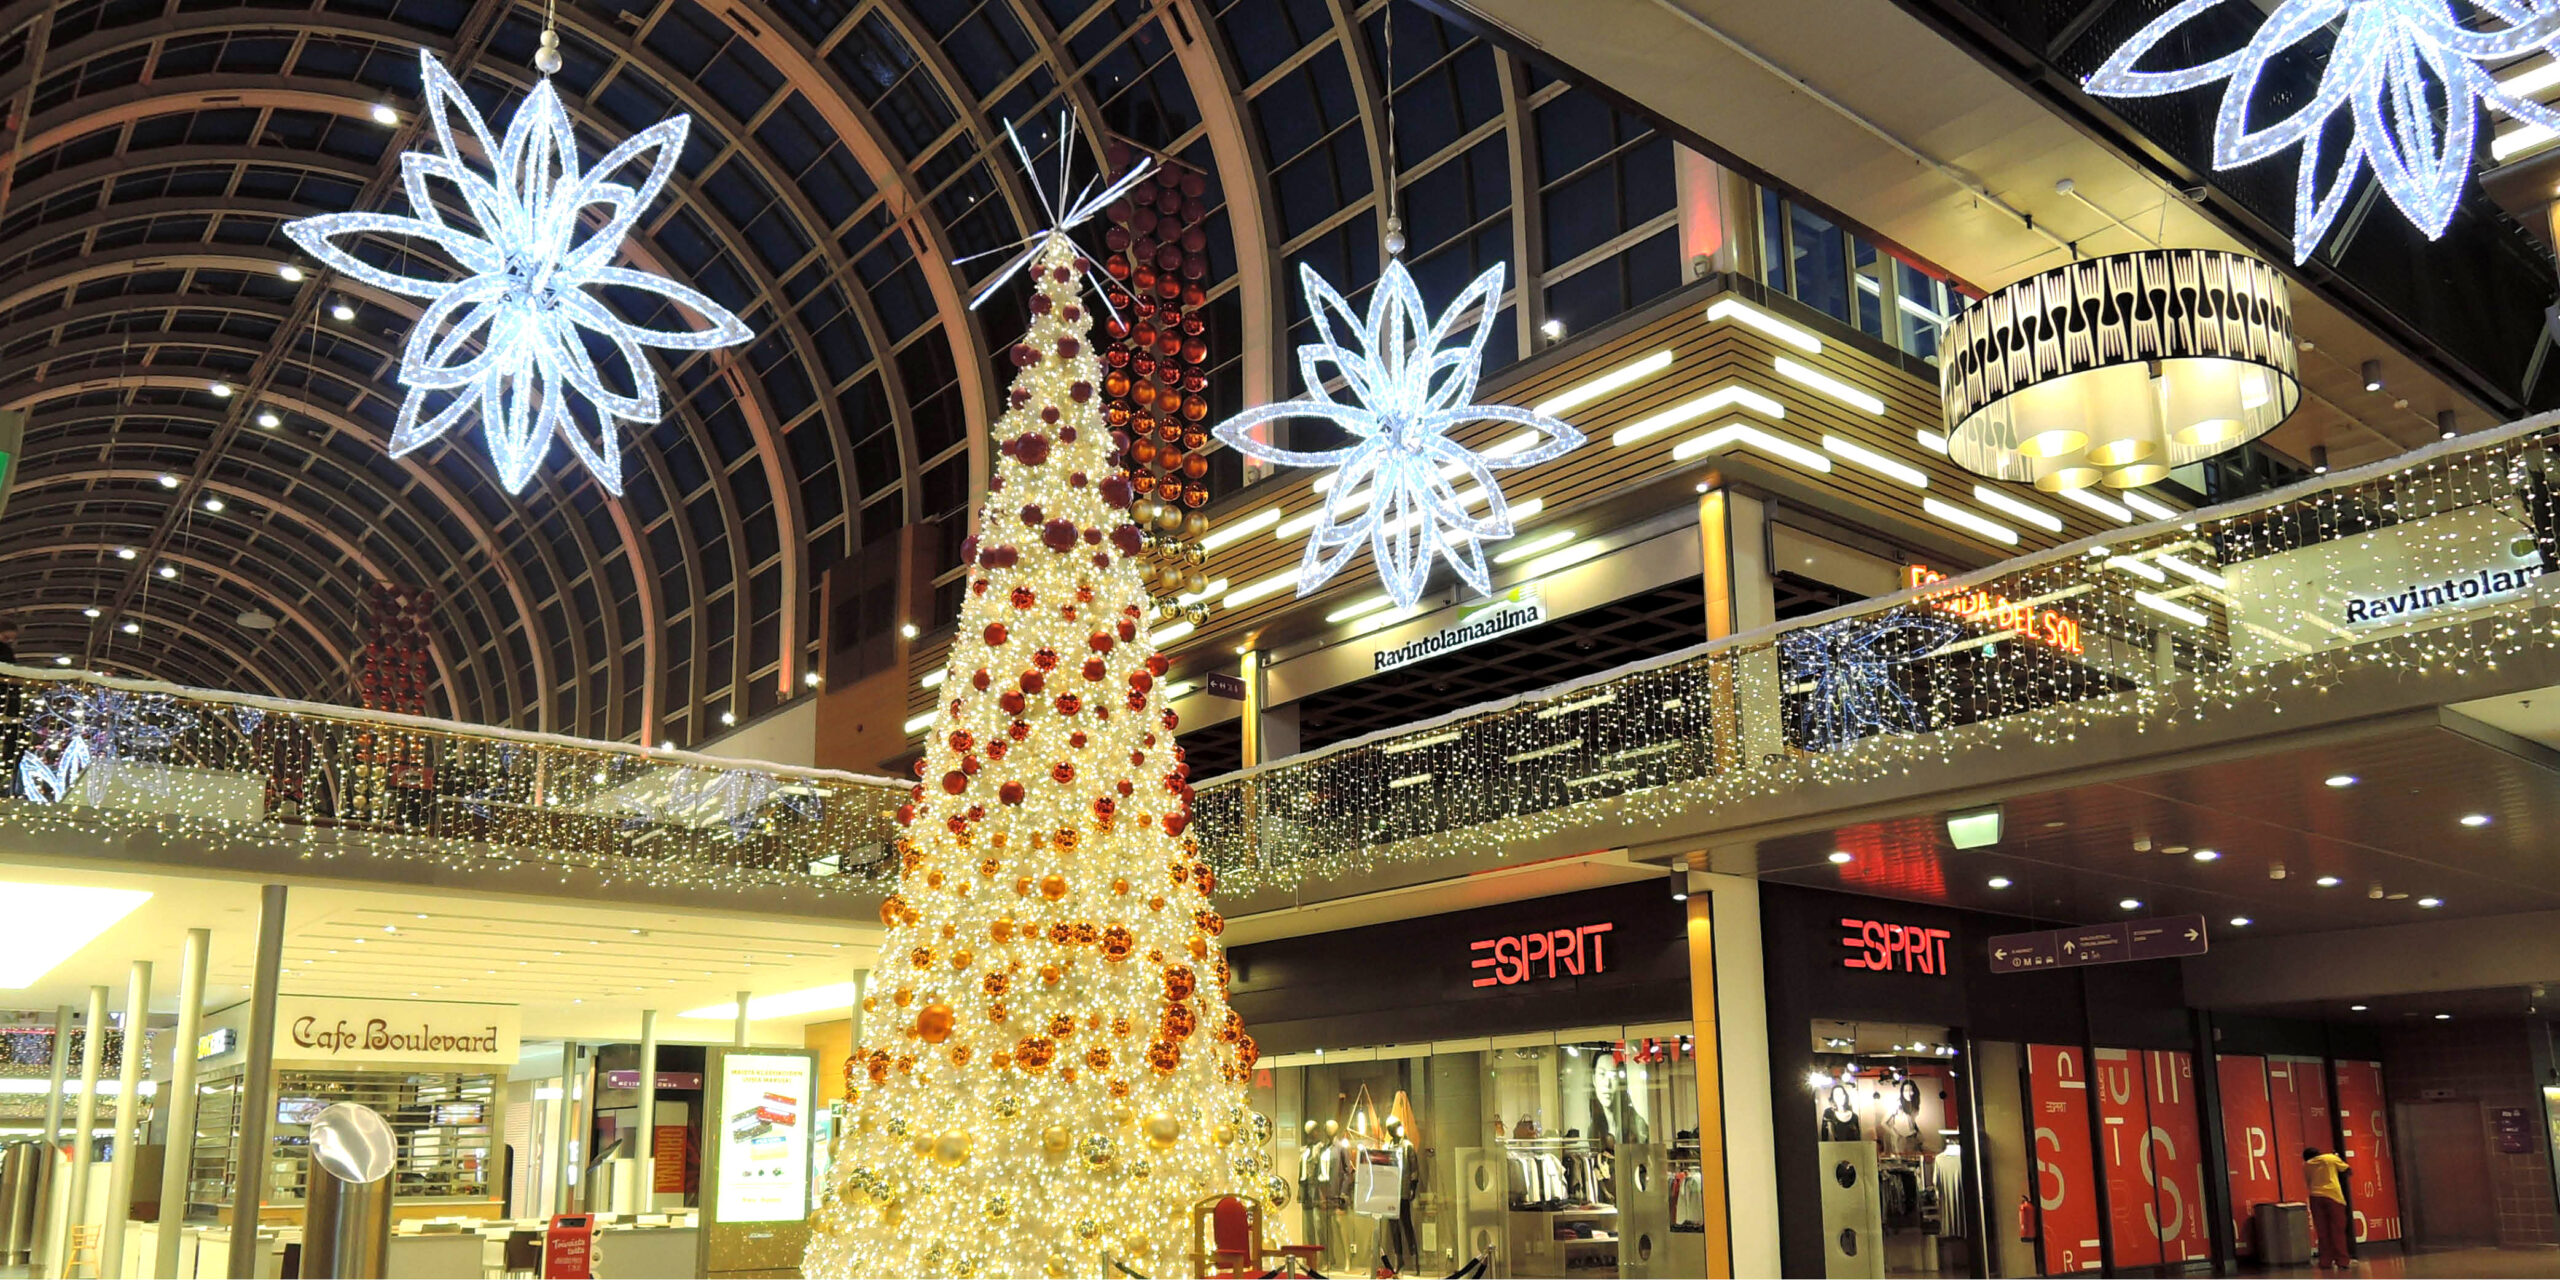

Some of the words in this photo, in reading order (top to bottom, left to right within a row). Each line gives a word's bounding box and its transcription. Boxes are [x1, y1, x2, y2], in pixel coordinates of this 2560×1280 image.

[1374, 604, 1539, 671] Ravintolamaailma
[1997, 595, 2040, 640] DEL
[2043, 609, 2085, 655] SOL
[1470, 922, 1613, 988] ESPRIT
[1841, 918, 1951, 976] ESPRIT
[292, 1016, 356, 1054] Cafe
[363, 1018, 498, 1053] Boulevard
